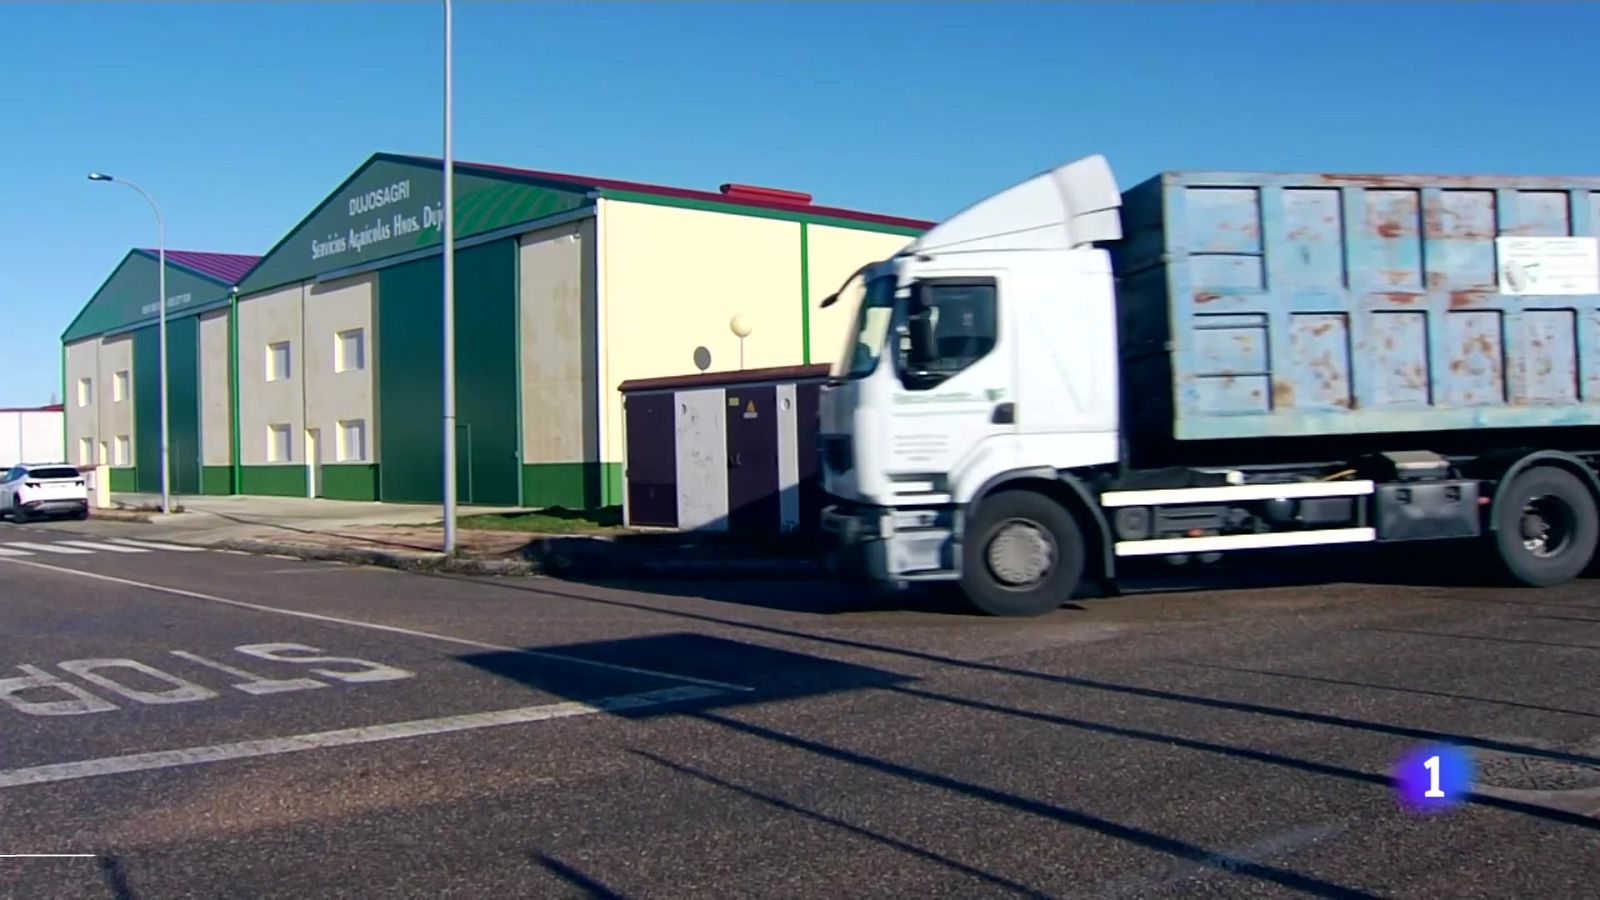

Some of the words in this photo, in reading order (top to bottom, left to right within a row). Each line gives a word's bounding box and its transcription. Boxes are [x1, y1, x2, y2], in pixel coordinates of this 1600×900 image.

[349, 179, 410, 216] DUJOSAGRI
[312, 233, 346, 260] Servicios
[0, 643, 416, 715] STOP
